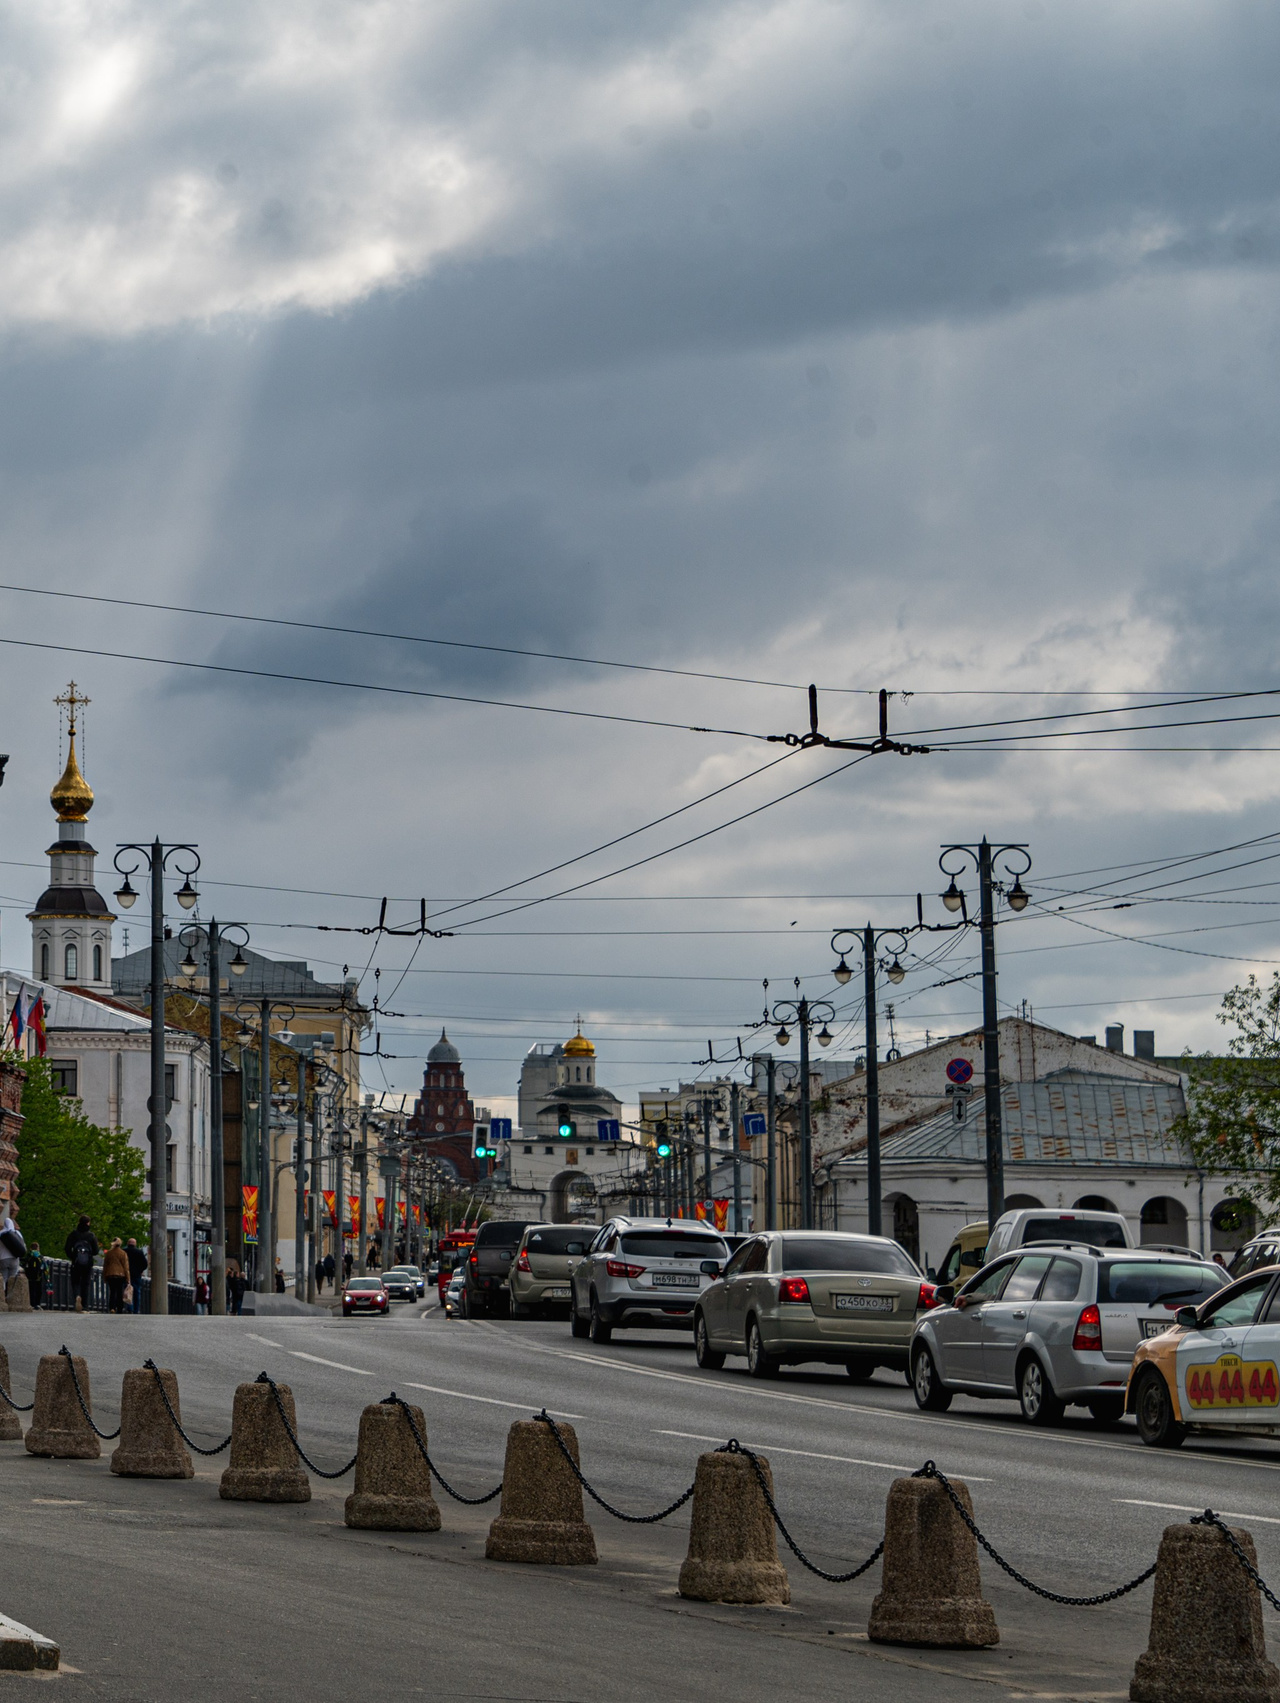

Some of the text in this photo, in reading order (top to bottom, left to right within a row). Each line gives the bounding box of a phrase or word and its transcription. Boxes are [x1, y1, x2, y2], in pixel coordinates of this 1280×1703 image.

[1190, 1367, 1276, 1405] 44 44 44
